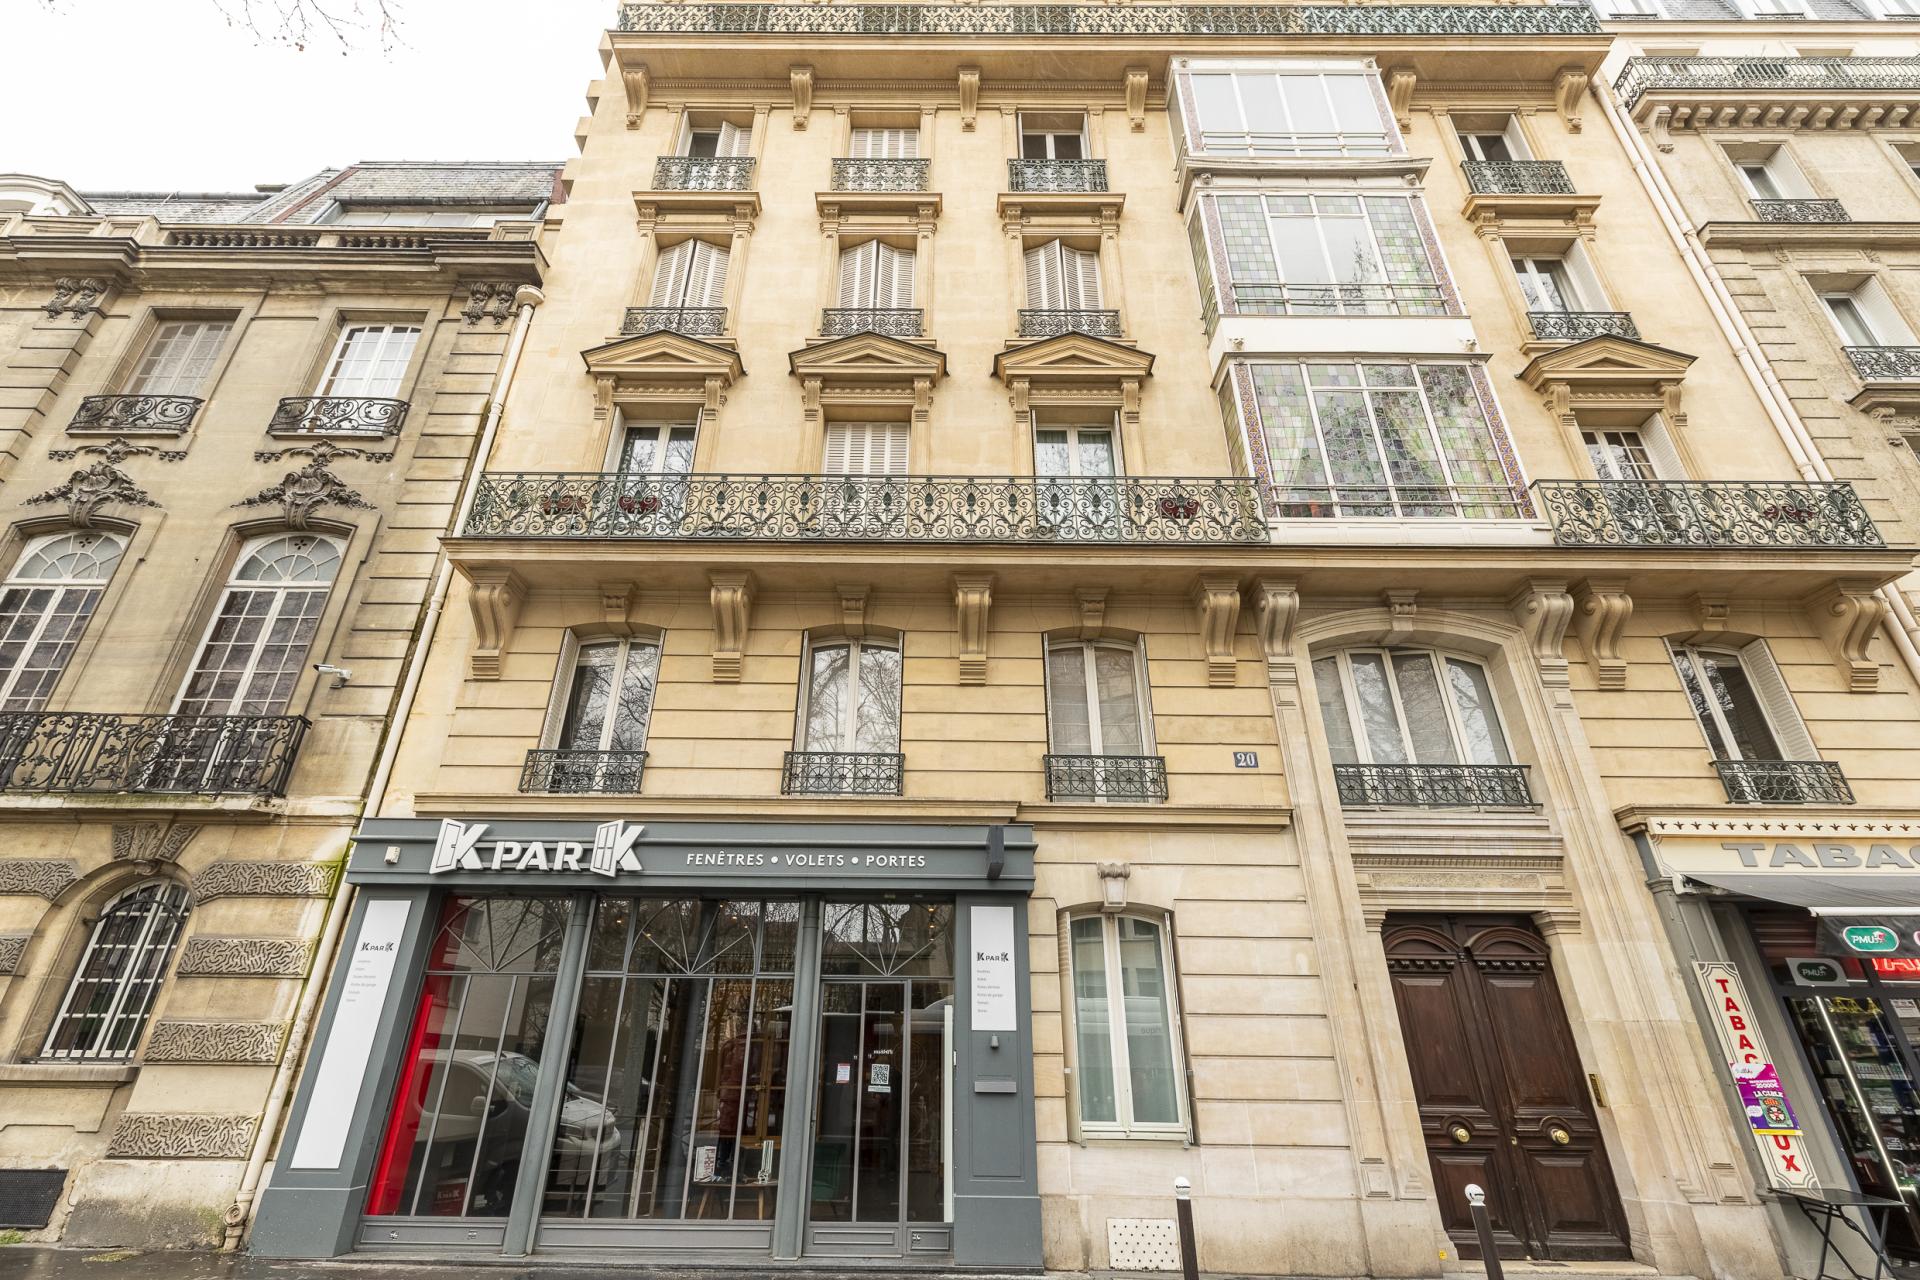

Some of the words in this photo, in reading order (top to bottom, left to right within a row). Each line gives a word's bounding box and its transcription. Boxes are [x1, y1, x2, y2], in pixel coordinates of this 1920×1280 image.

[1236, 752, 1255, 766] 20
[491, 841, 581, 871] PAR
[686, 850, 764, 866] FENÊTRES
[785, 854, 845, 867] VOLETS
[866, 855, 926, 868] PORTES
[1721, 842, 1920, 869] TABA
[1852, 935, 1875, 944] PMU
[1802, 968, 1821, 976] PMU
